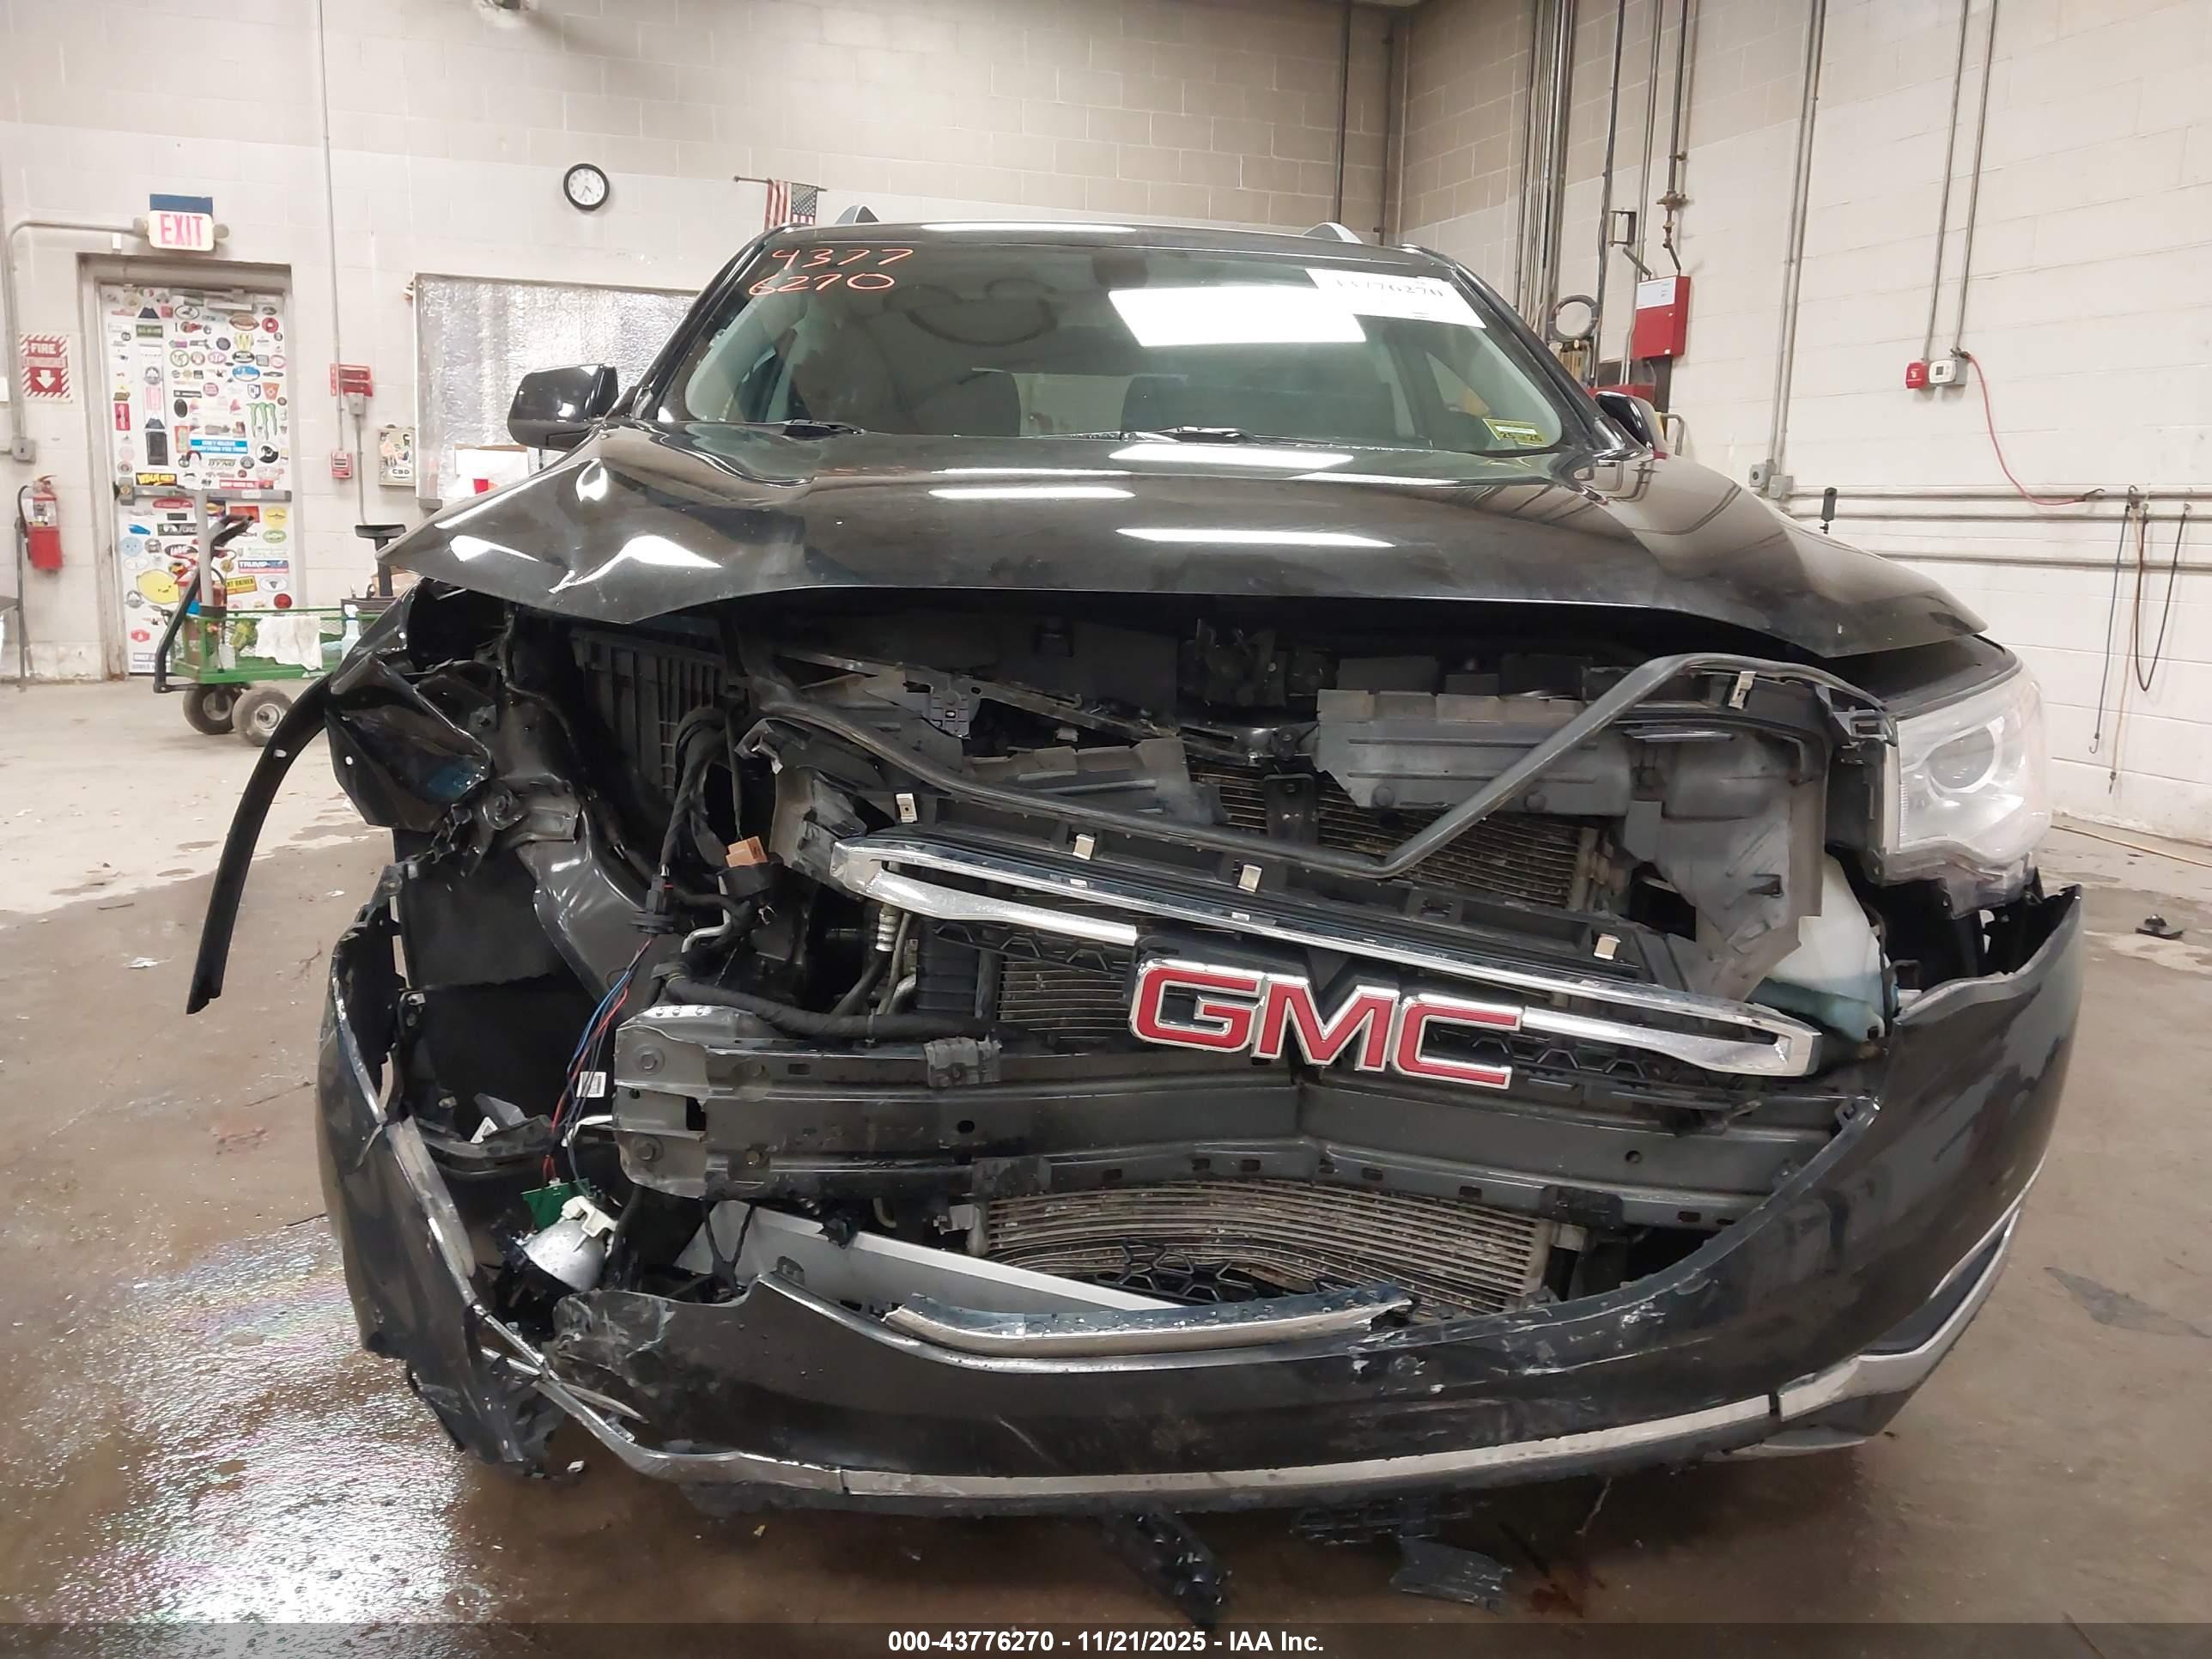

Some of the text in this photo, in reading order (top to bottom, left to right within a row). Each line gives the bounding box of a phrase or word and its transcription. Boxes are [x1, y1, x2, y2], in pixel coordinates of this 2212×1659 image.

[160, 214, 204, 246] EXIT
[771, 248, 914, 270] 4377
[749, 273, 896, 296] 6270
[30, 342, 57, 355] FIRE
[1128, 957, 1525, 1091] GMC
